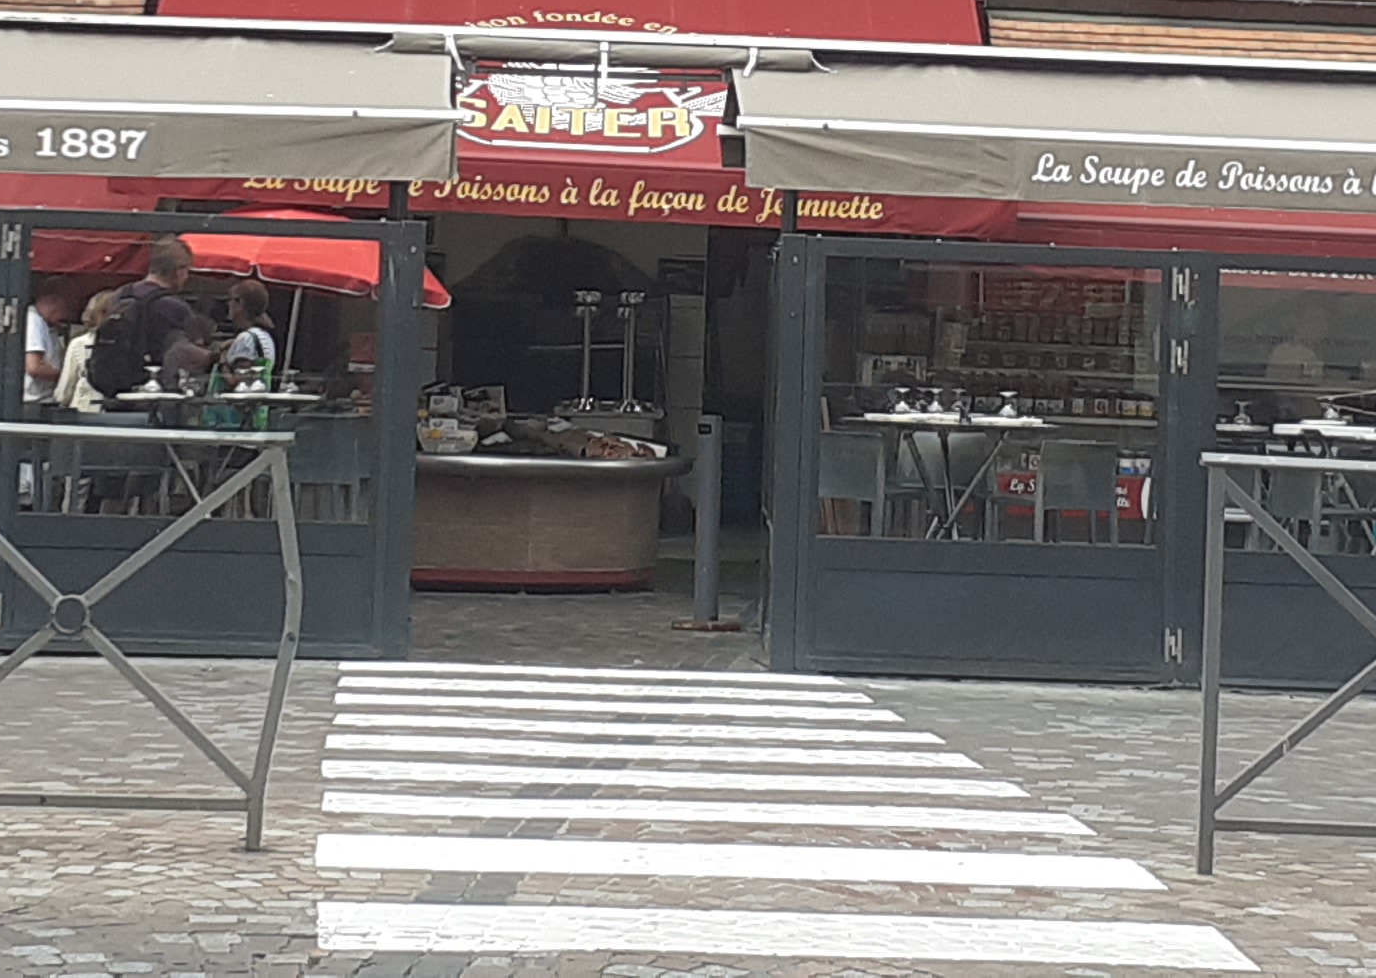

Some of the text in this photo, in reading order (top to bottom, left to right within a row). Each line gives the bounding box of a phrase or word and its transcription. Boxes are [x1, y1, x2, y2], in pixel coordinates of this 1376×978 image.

[455, 96, 691, 138] SAITER
[35, 127, 147, 159] 1887
[1031, 153, 1073, 184] La
[1080, 155, 1166, 194] Soupe
[1175, 159, 1208, 188] de
[1218, 160, 1333, 194] Poissons
[1342, 167, 1363, 196] à
[560, 176, 580, 205] à
[588, 178, 621, 207] la
[628, 179, 707, 217] façon
[716, 185, 750, 213] de
